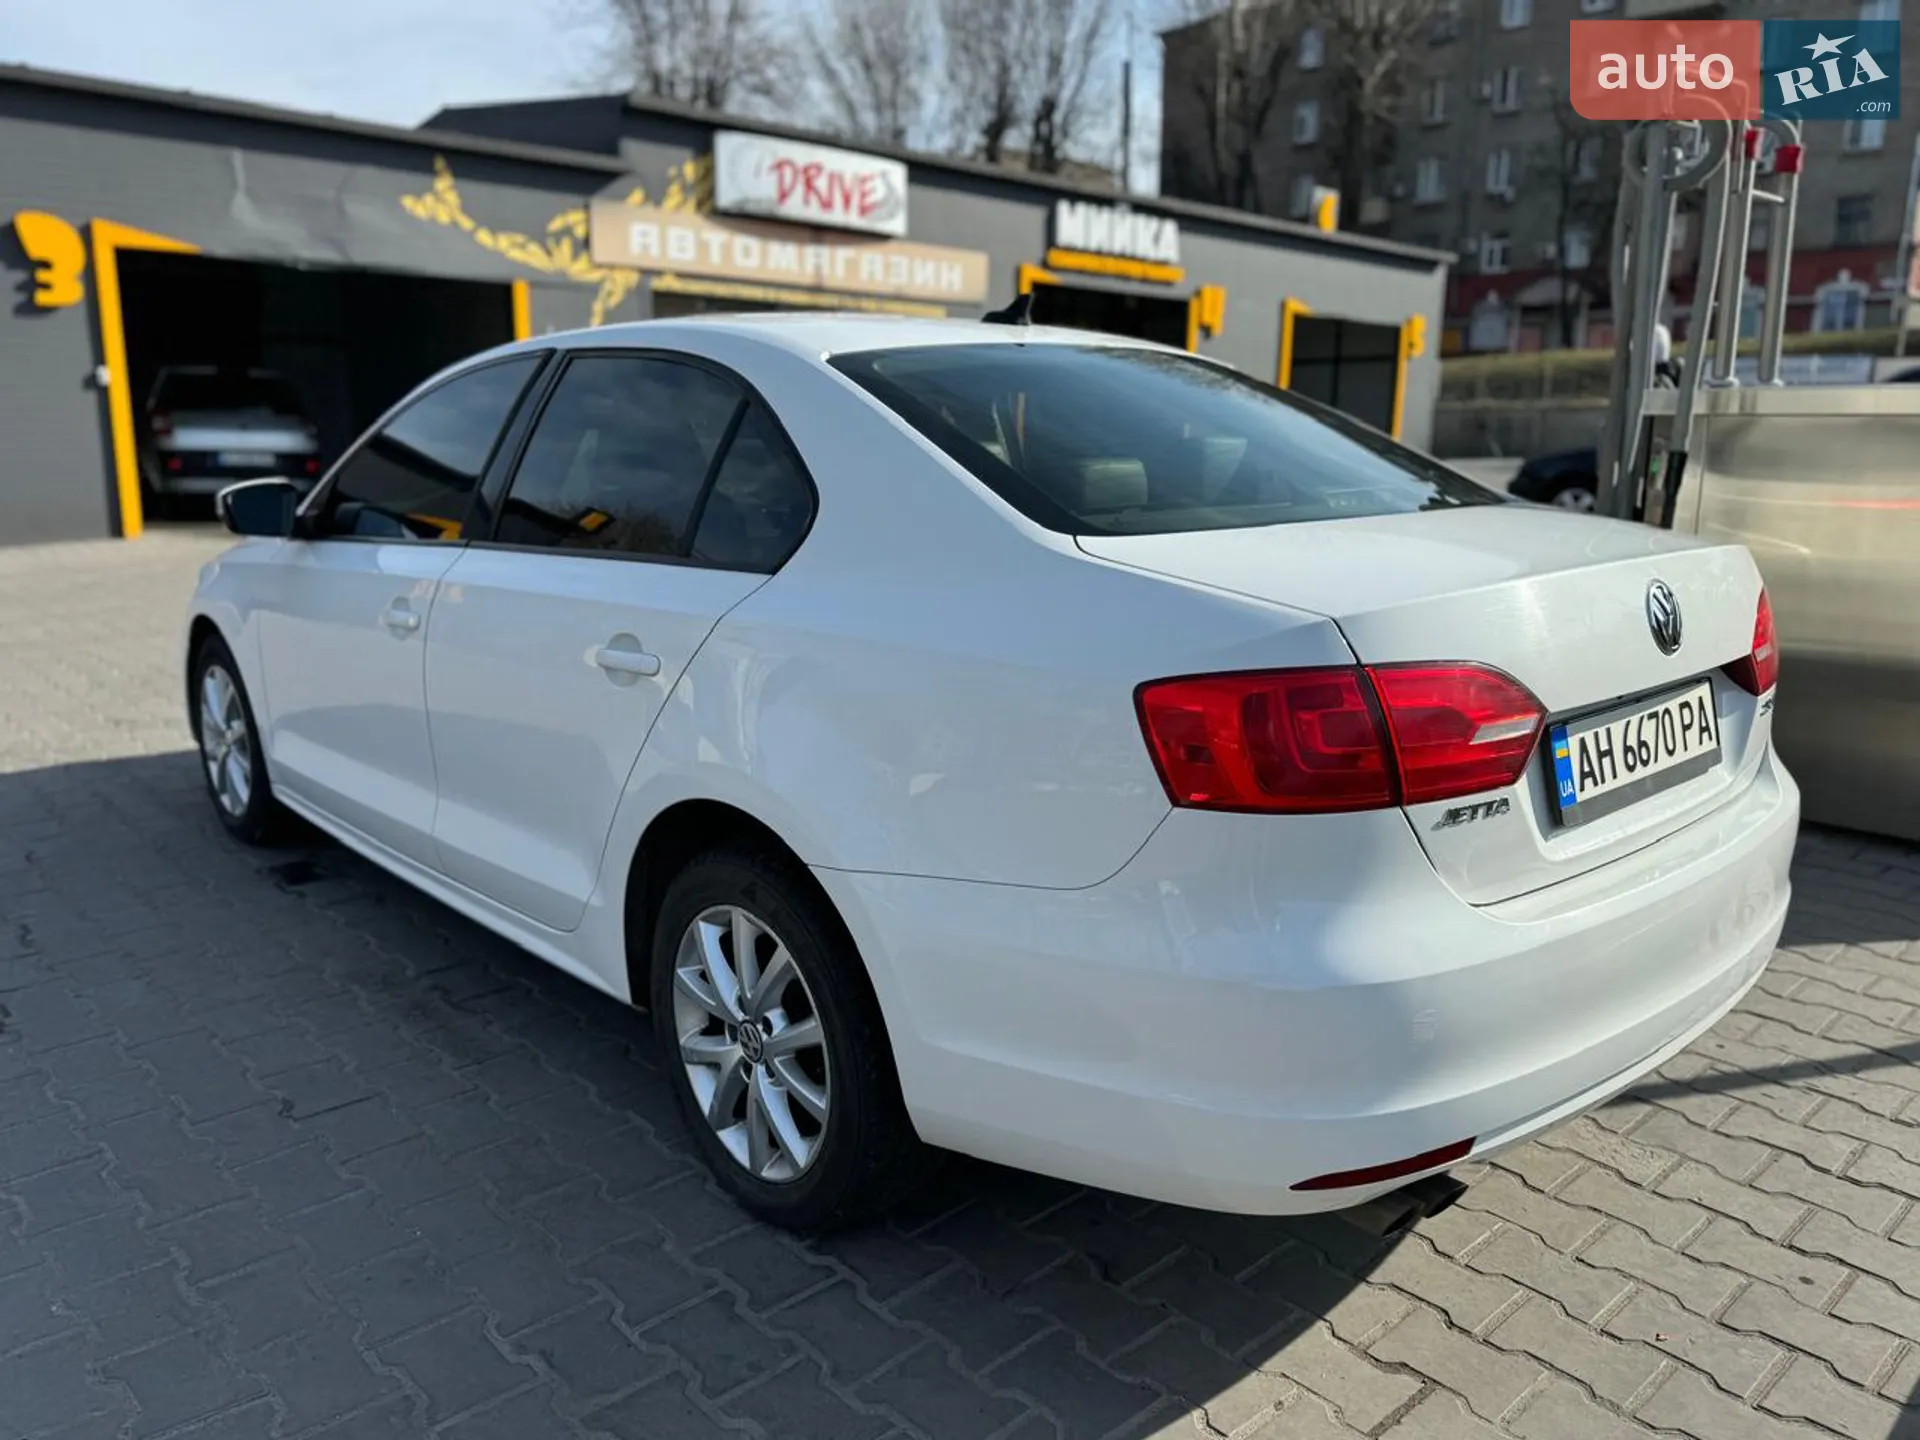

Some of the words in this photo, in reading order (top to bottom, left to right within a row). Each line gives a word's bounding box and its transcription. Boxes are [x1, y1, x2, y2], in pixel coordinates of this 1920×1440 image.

[768, 157, 883, 220] DRIVE
[13, 209, 87, 307] 3
[629, 220, 965, 293] АВТОМАГАЗИН
[1579, 726, 1618, 793] AH
[1622, 706, 1677, 774] 6670
[1678, 695, 1713, 752] PA
[1560, 777, 1575, 797] UA
